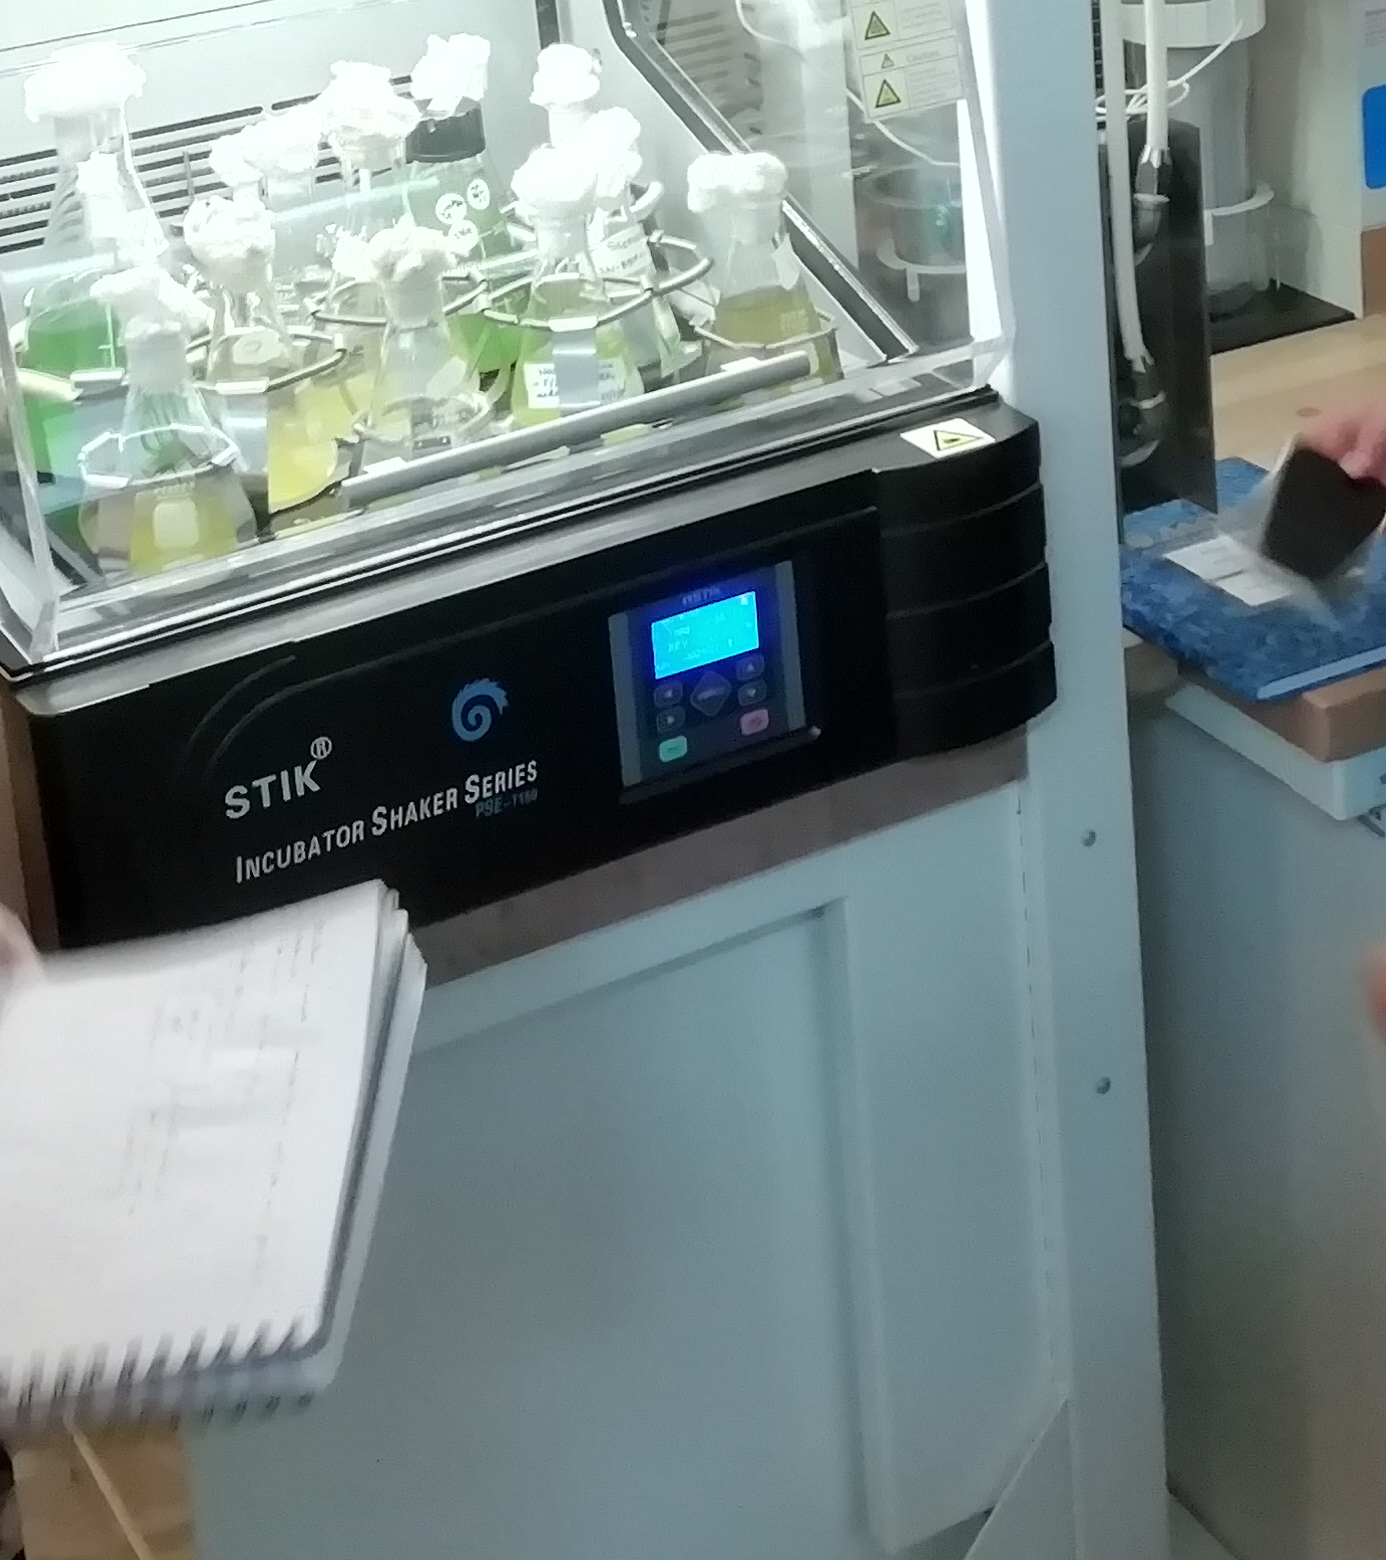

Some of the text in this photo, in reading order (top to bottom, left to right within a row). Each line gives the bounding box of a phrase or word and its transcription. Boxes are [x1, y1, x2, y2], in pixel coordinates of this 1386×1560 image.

[236, 759, 538, 884] INCUBATOR SHAKER SERIES
